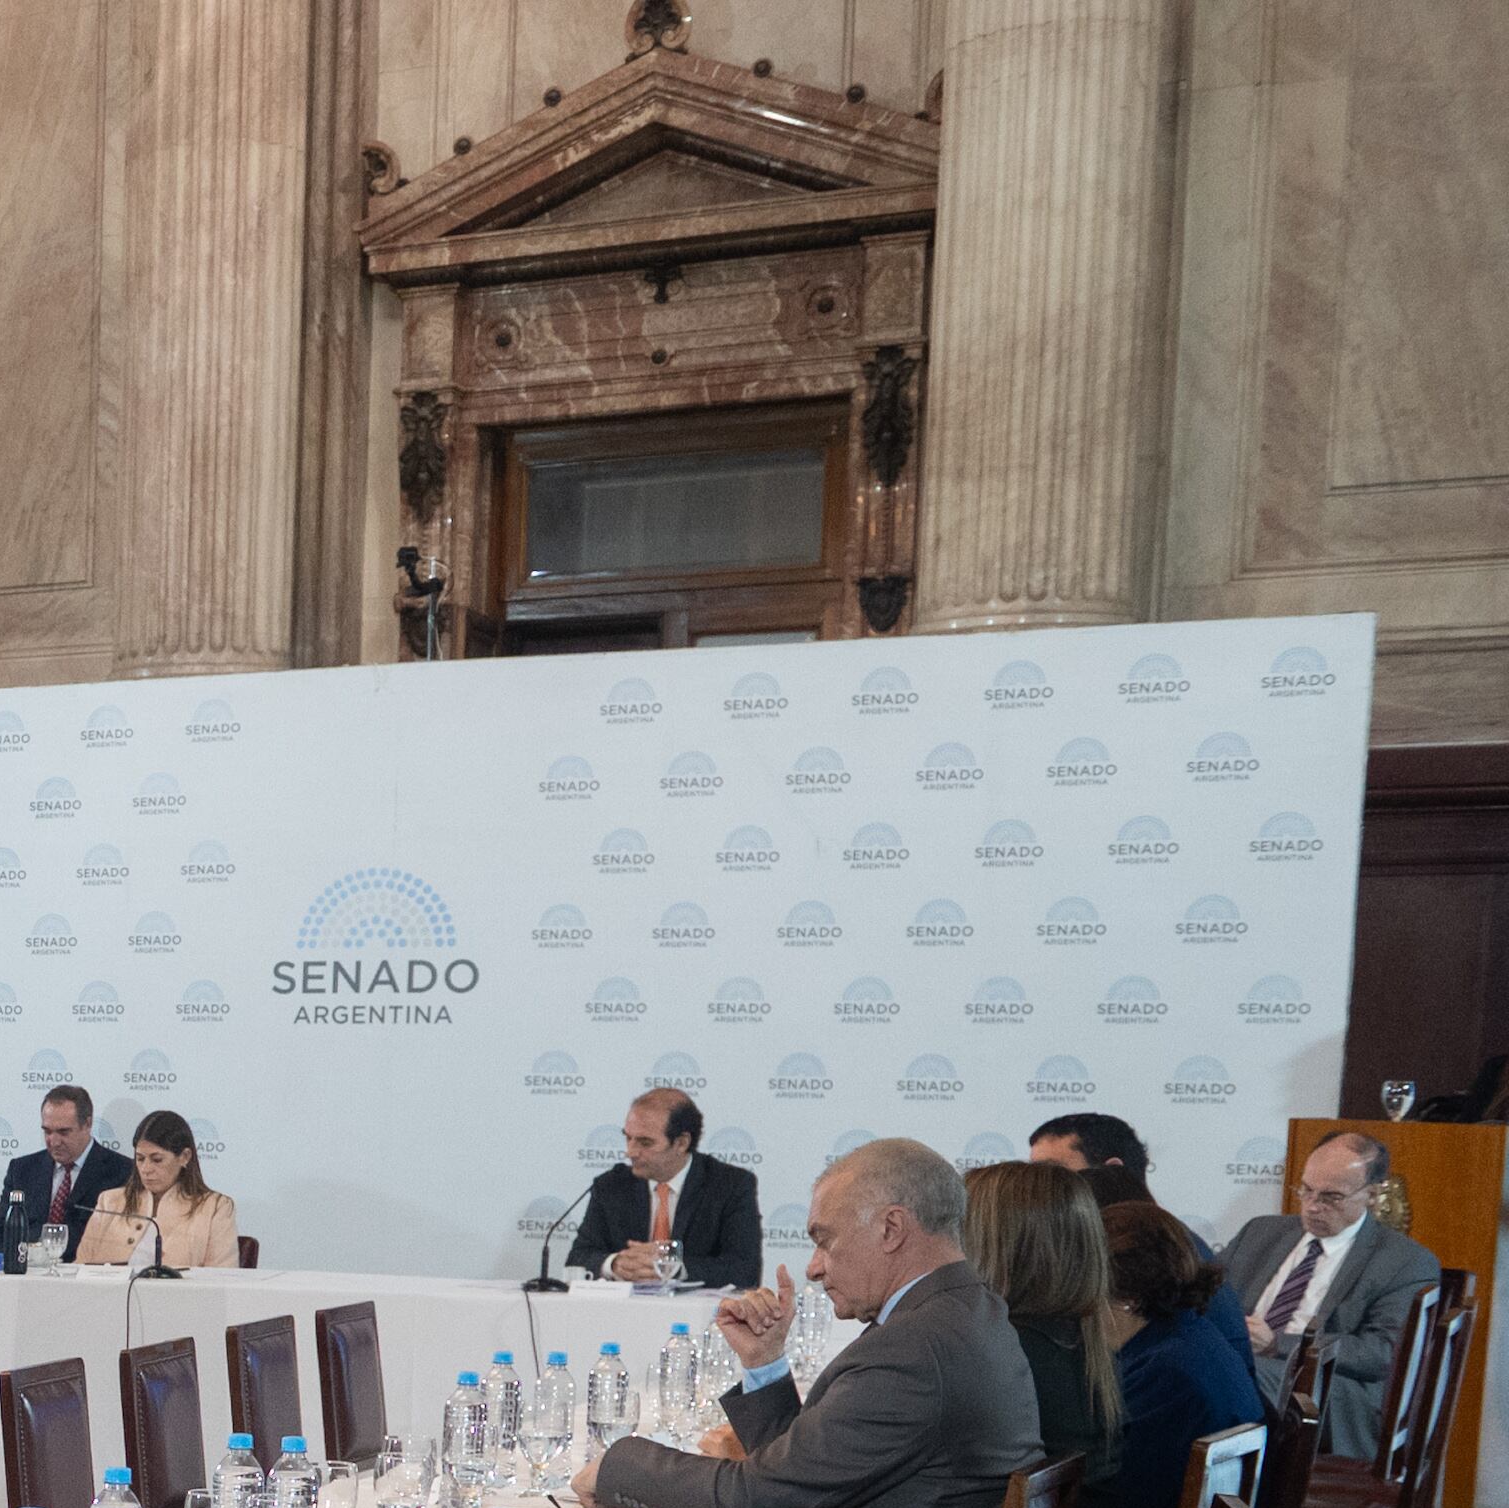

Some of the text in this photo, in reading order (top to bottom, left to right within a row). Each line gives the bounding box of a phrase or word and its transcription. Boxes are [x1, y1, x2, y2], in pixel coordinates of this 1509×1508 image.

[1261, 673, 1336, 689] SENADO
[1118, 680, 1191, 695] SENADO
[852, 692, 919, 706] SENADO
[984, 687, 1054, 701] SENADO
[600, 703, 662, 716] SENADO
[724, 698, 788, 711] SENADO
[80, 729, 134, 741] SENADO
[185, 723, 241, 735] SENADO
[1047, 764, 1118, 778] SENADO
[1186, 759, 1260, 773] SENADO
[786, 772, 851, 785] SENADO
[916, 769, 984, 782] SENADO
[539, 780, 600, 793] SENADO
[660, 776, 723, 789] SENADO
[30, 800, 82, 811] SENADO
[133, 795, 186, 807] SENADO
[1108, 842, 1179, 856] SENADO
[1249, 839, 1324, 853] SENADO
[716, 851, 780, 863] SENADO
[843, 849, 910, 861] SENADO
[975, 846, 1044, 859] SENADO
[593, 854, 655, 865] SENADO
[77, 867, 129, 878] SENADO
[181, 864, 235, 875] SENADO
[532, 929, 593, 940] SENADO
[652, 928, 715, 939] SENADO
[777, 927, 842, 938] SENADO
[906, 926, 974, 938] SENADO
[1036, 924, 1107, 936] SENADO
[1175, 922, 1248, 935] SENADO
[25, 937, 78, 948] SENADO
[128, 935, 182, 946] SENADO
[271, 959, 480, 994] SENADO
[72, 1004, 125, 1015] SENADO
[176, 1004, 230, 1014] SENADO
[585, 1002, 647, 1014] SENADO
[707, 1003, 771, 1014] SENADO
[834, 1003, 900, 1015] SENADO
[965, 1003, 1034, 1015] SENADO
[1097, 1003, 1168, 1015] SENADO
[1238, 1003, 1311, 1015] SENADO
[293, 1005, 452, 1025] ARGENTINA
[22, 1072, 73, 1082] SENADO
[123, 1072, 177, 1083] SENADO
[525, 1076, 585, 1087] SENADO
[644, 1077, 707, 1088] SENADO
[768, 1078, 833, 1090] SENADO
[897, 1080, 964, 1092] SENADO
[1026, 1082, 1096, 1094] SENADO
[1164, 1083, 1236, 1095] SENADO
[197, 1142, 226, 1152] ADO
[578, 1149, 627, 1160] SENAD
[1226, 1163, 1284, 1175] SENAD
